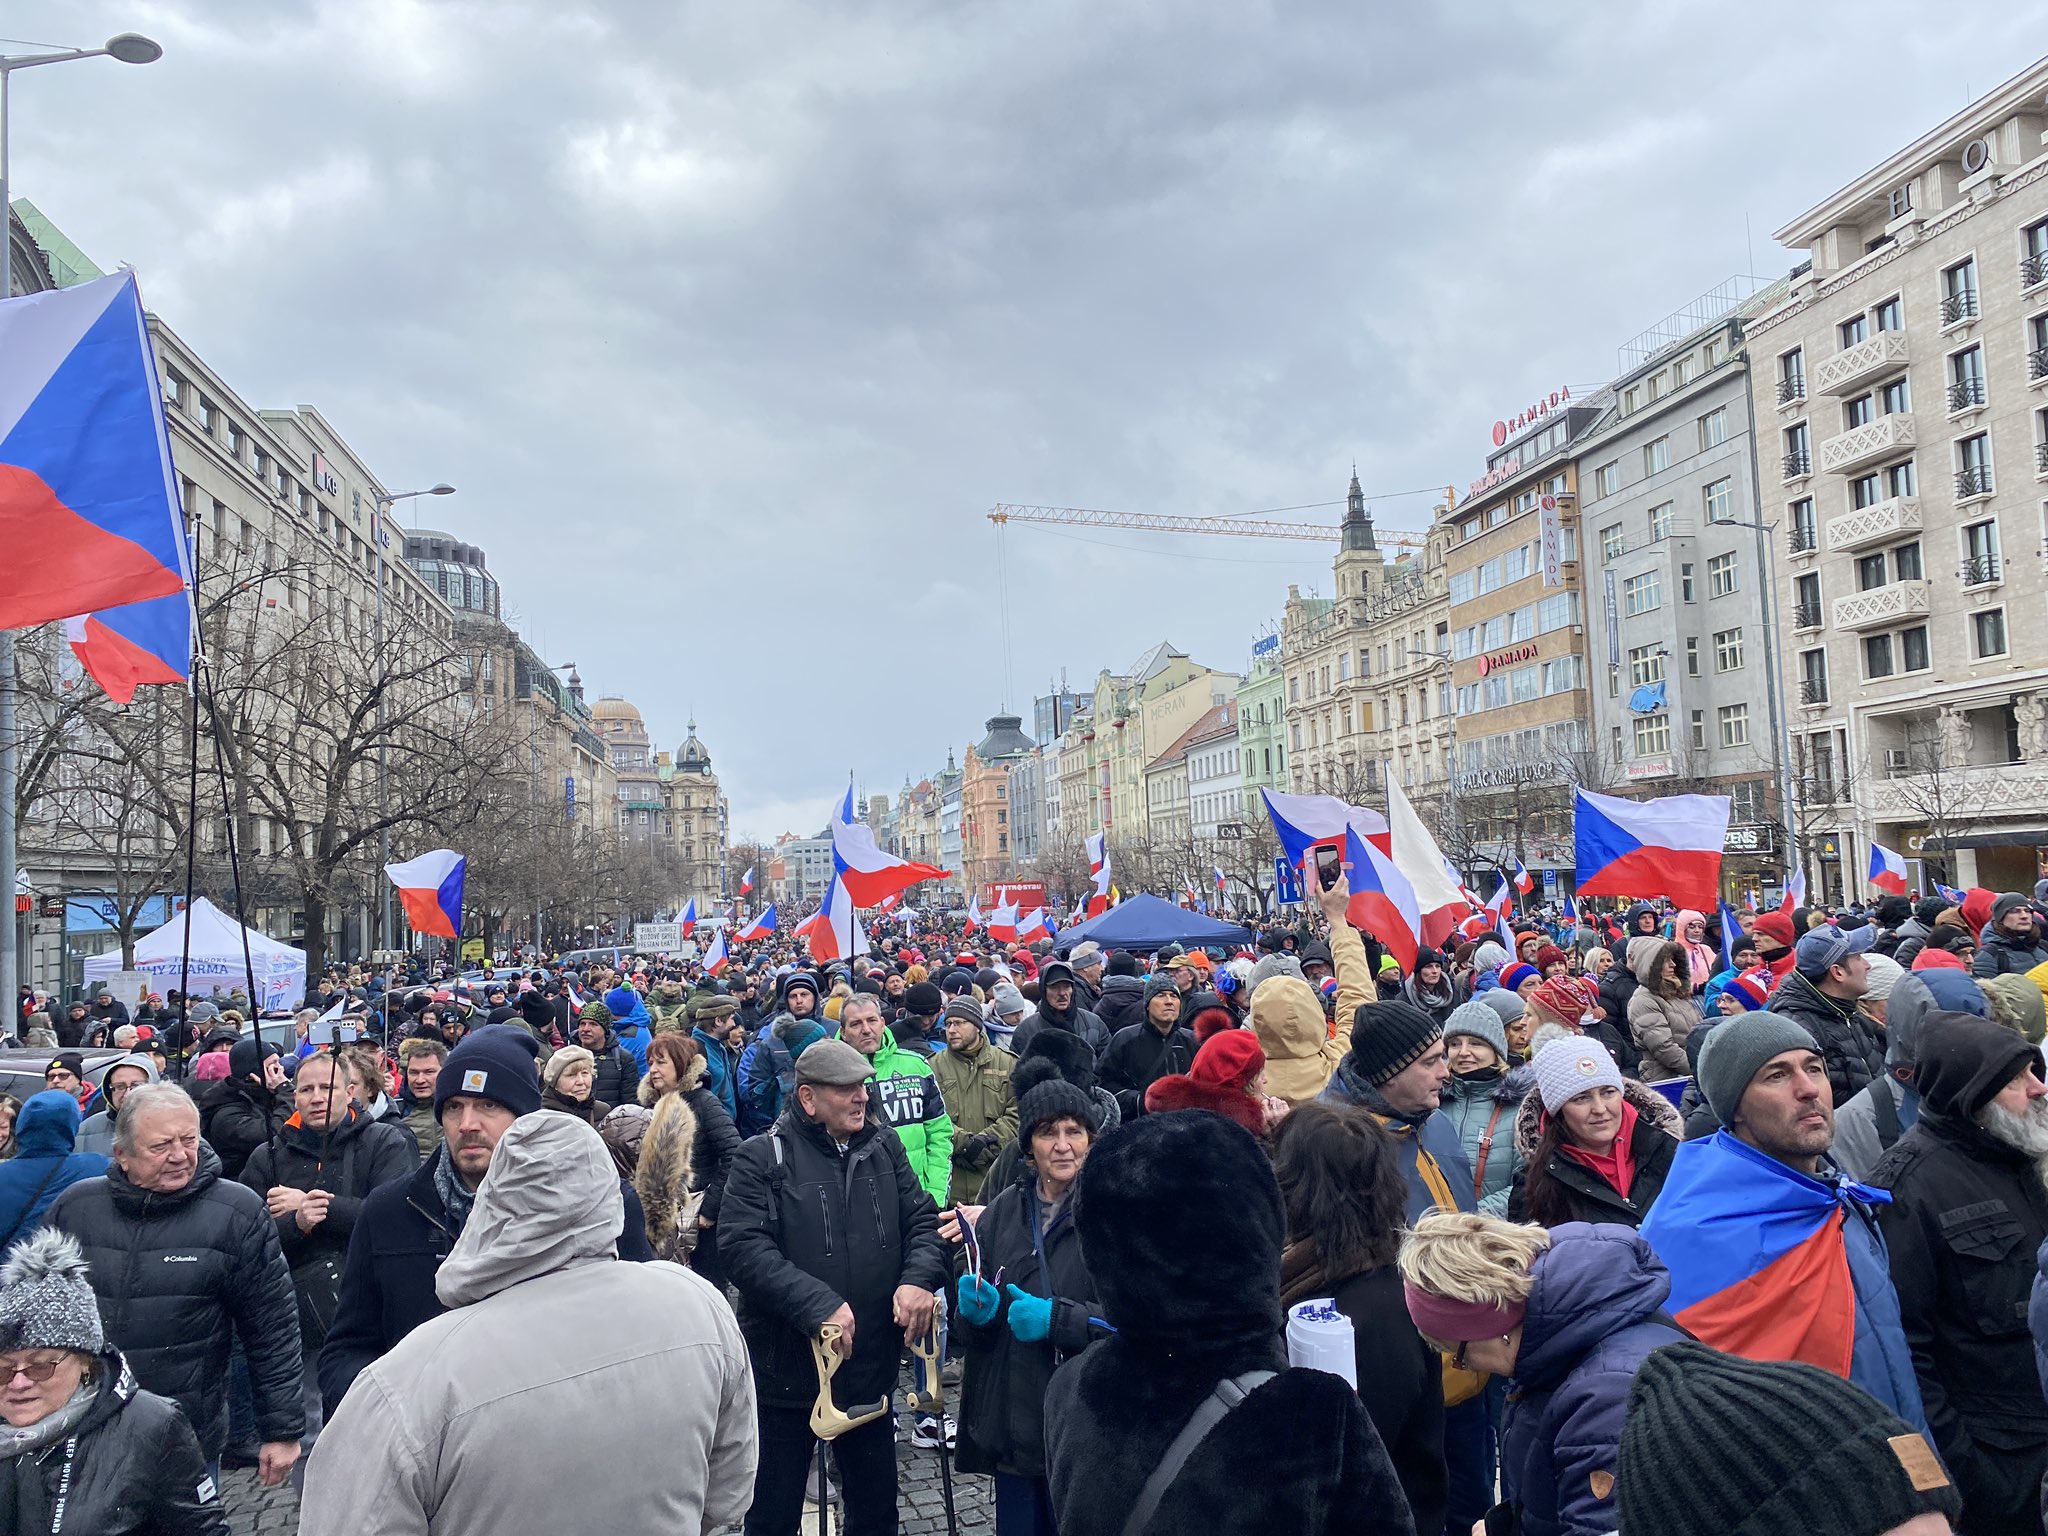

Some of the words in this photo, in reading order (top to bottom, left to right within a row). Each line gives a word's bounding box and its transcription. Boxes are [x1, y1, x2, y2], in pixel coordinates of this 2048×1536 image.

[1508, 385, 1570, 433] RAMADA
[325, 472, 337, 497] KB
[1546, 517, 1557, 585] RAMADA
[1254, 634, 1278, 656] CASINO
[1490, 644, 1538, 669] RAMADA
[1151, 695, 1185, 720] MERAN
[1461, 769, 1490, 790] PALÁC
[1492, 766, 1518, 787] KNIH
[1520, 762, 1554, 781] LUXOR
[883, 1097, 923, 1122] VID
[170, 1255, 198, 1263] Columbia
[65, 1438, 77, 1459] KEEP
[59, 1462, 72, 1494] MOVING
[52, 1498, 66, 1535] FORWARD
